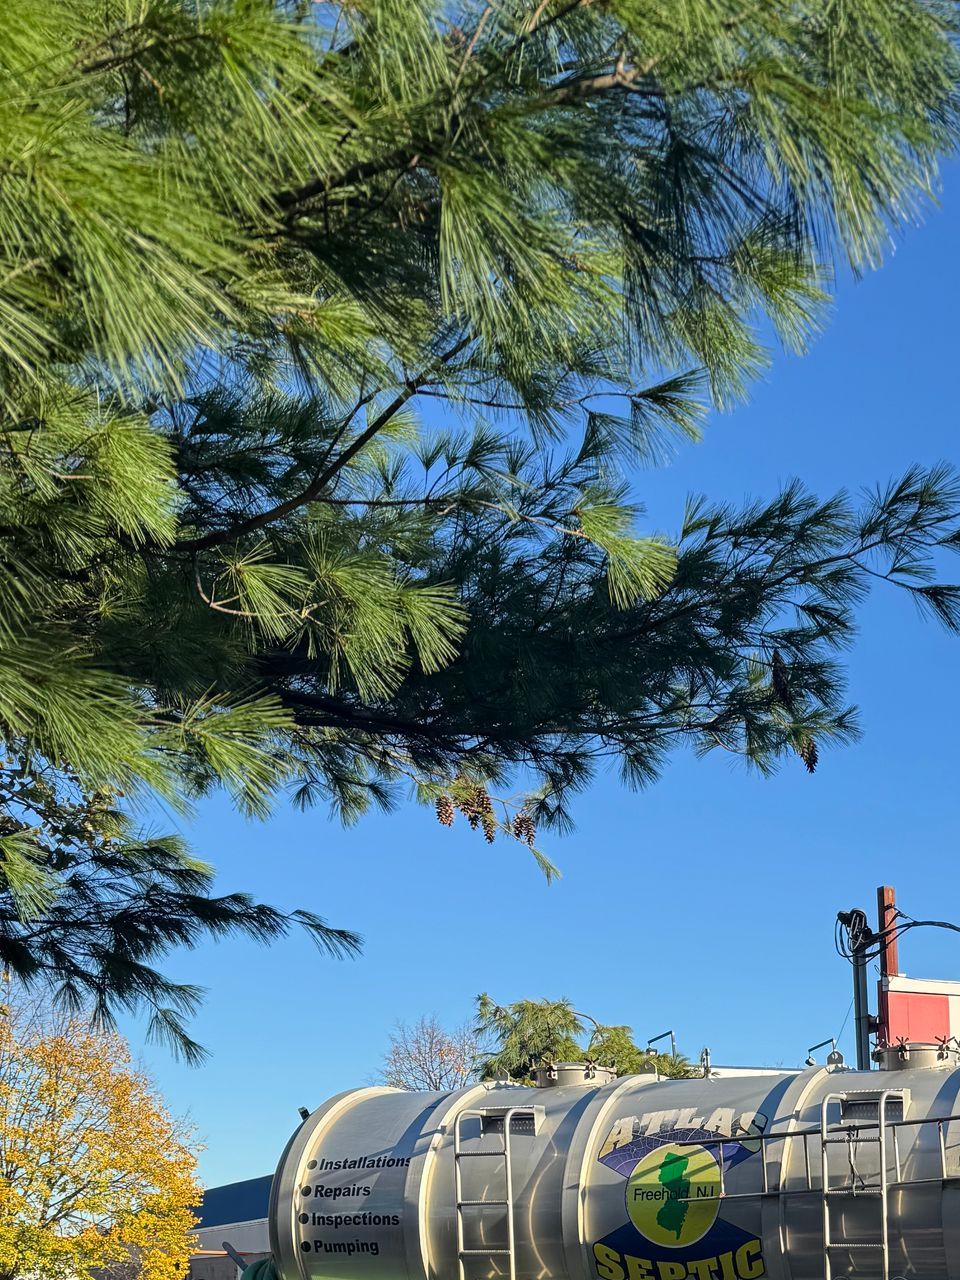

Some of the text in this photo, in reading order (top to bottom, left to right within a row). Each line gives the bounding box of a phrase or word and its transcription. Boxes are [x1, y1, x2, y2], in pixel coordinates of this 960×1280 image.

[598, 1107, 768, 1160] ATLAS
[319, 1156, 411, 1170] Installations
[314, 1184, 371, 1200] Repairs
[312, 1212, 400, 1229] Inspections
[313, 1239, 379, 1256] Pumping
